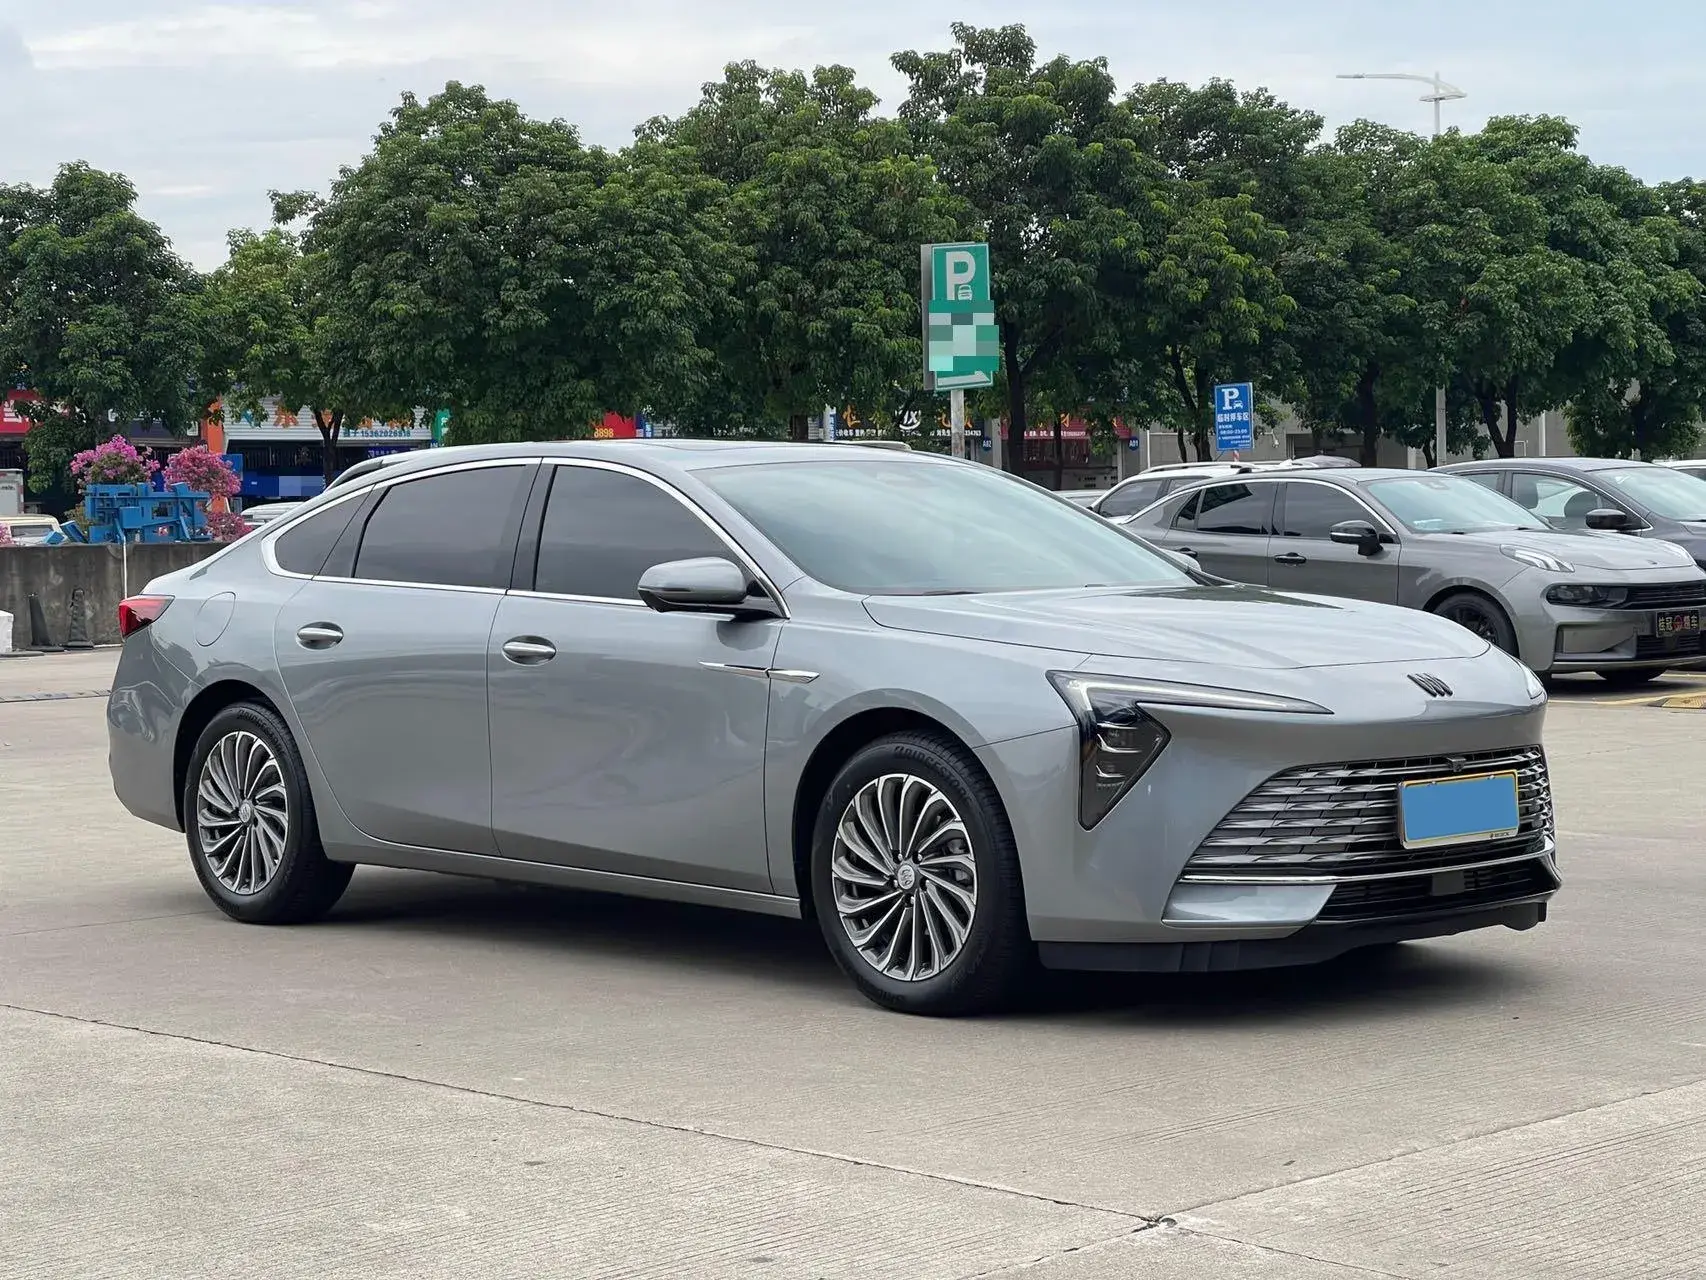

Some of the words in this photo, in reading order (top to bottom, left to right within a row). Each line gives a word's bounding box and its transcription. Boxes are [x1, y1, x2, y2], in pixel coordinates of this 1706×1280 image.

[945, 251, 975, 301] P
[1221, 388, 1240, 410] P
[893, 745, 972, 803] BRIDGESTONE
